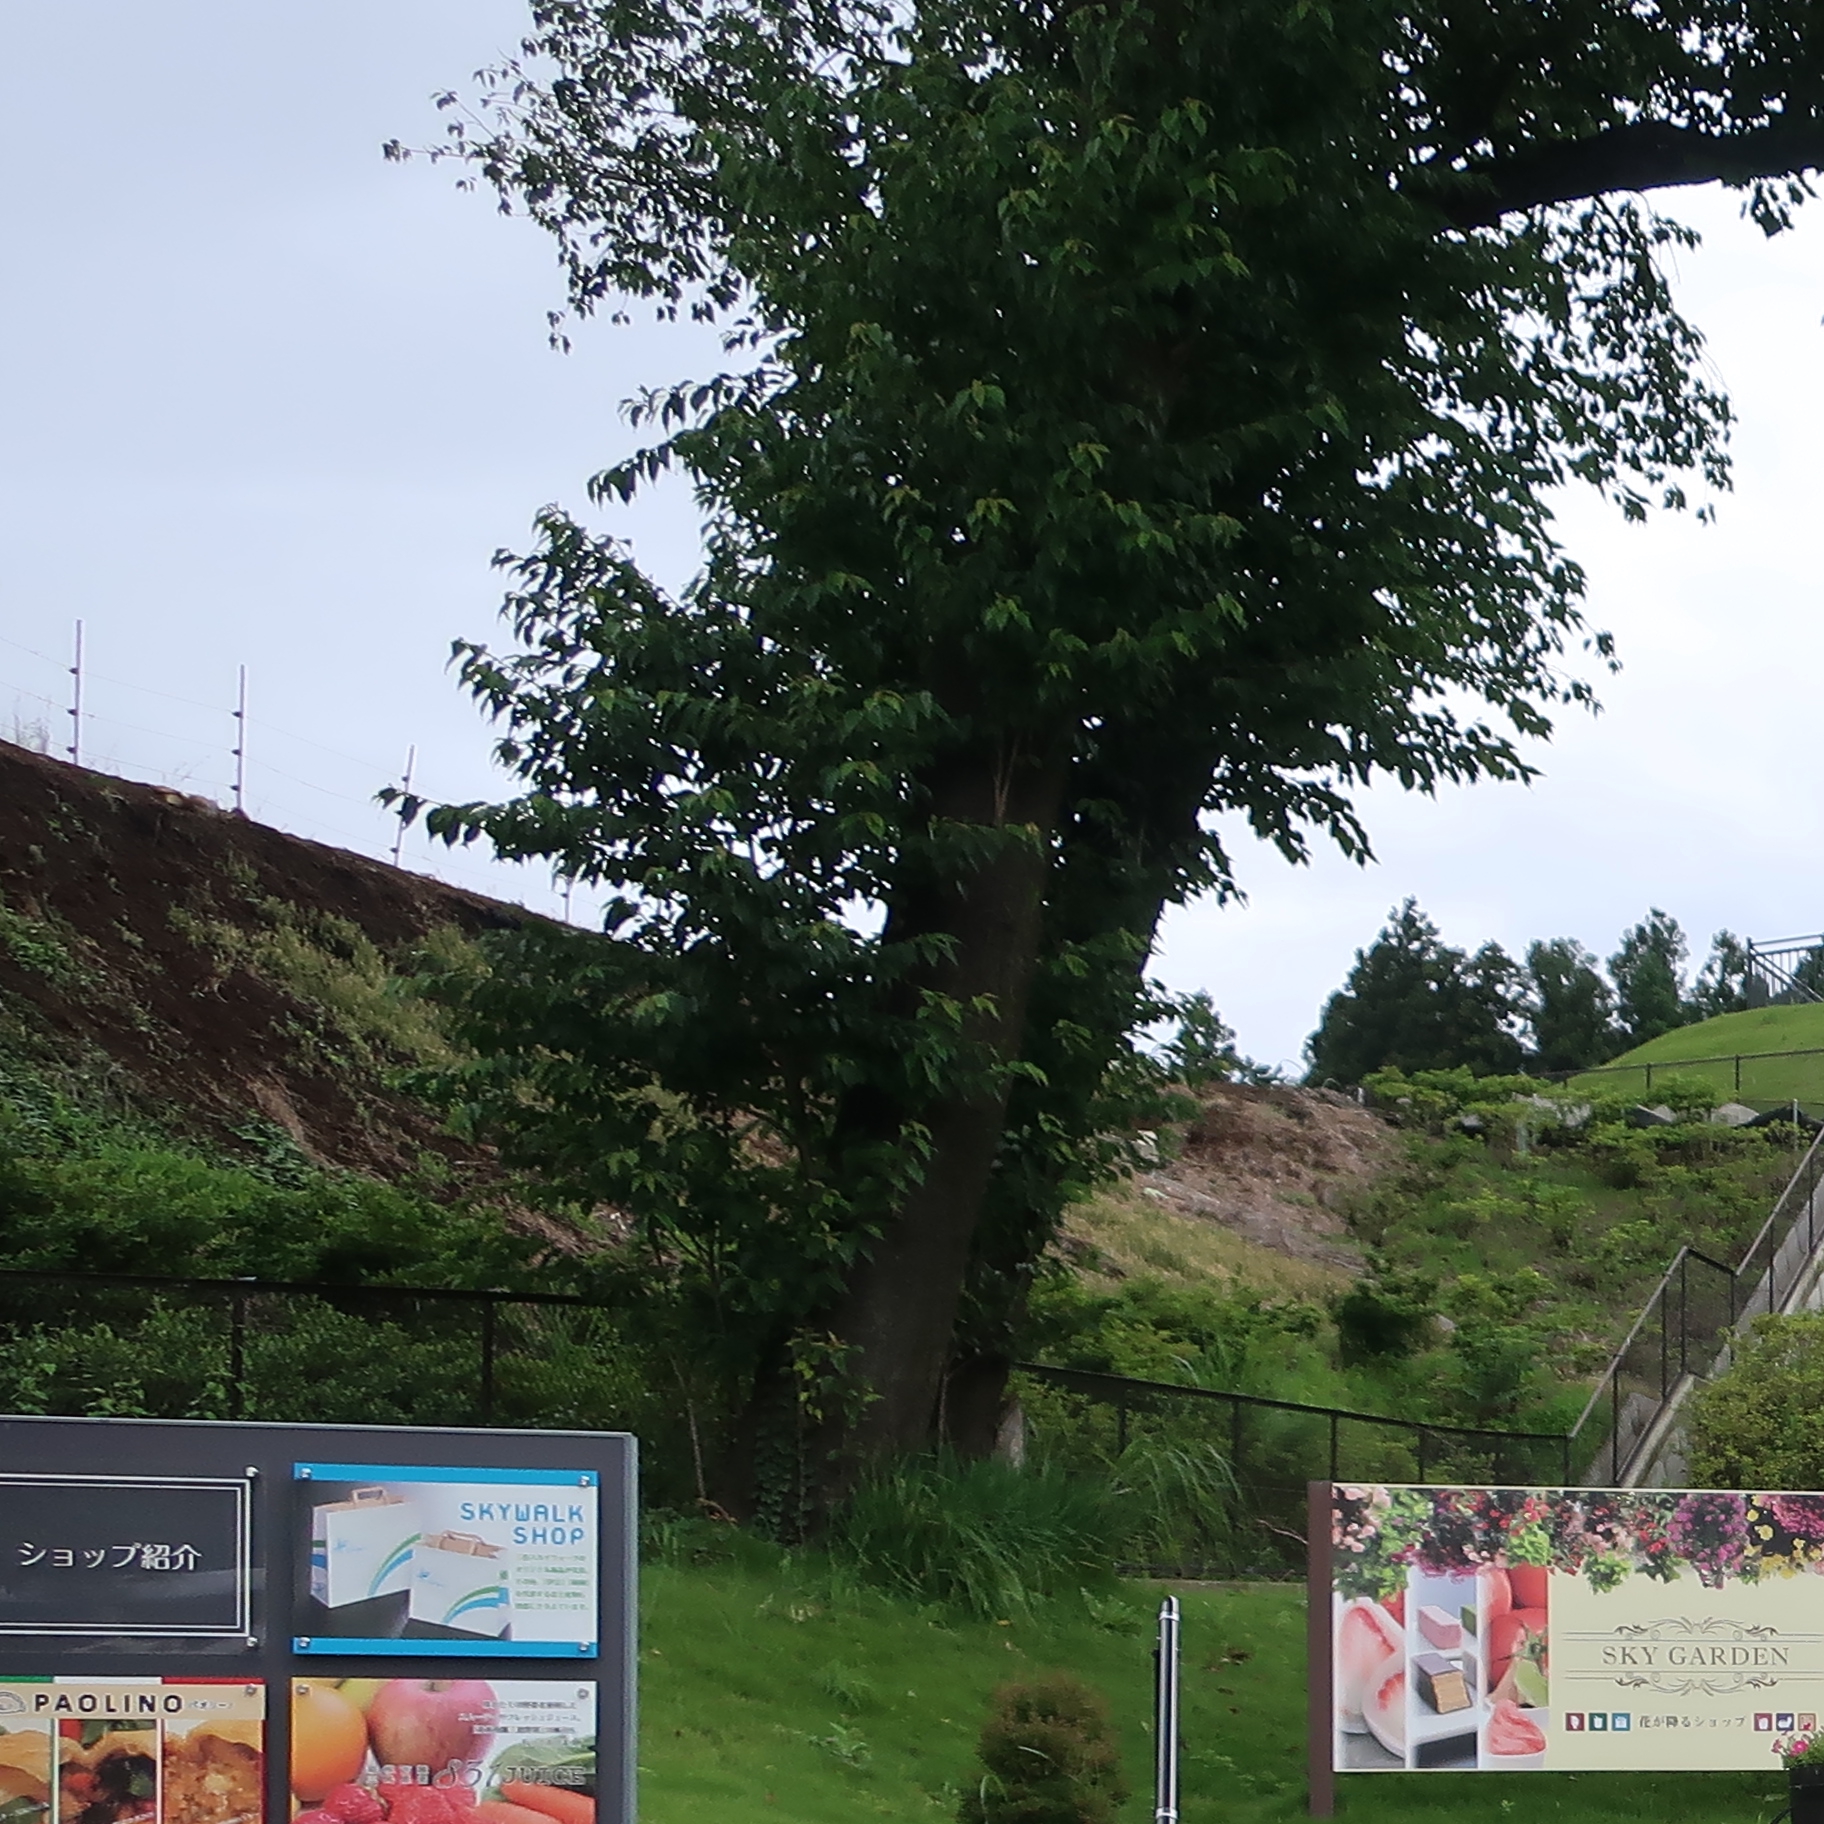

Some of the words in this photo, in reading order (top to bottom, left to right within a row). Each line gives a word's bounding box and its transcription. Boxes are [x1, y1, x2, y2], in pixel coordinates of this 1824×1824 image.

[460, 1502, 584, 1523] SKYWALK
[513, 1526, 584, 1546] SHOP
[18, 1541, 202, 1571] ショップ紹介
[1602, 1646, 1658, 1666] SKY
[1668, 1646, 1790, 1666] GARDEN
[34, 1694, 183, 1712] PAOLINO
[1639, 1715, 1747, 1729] 花が降るショップ
